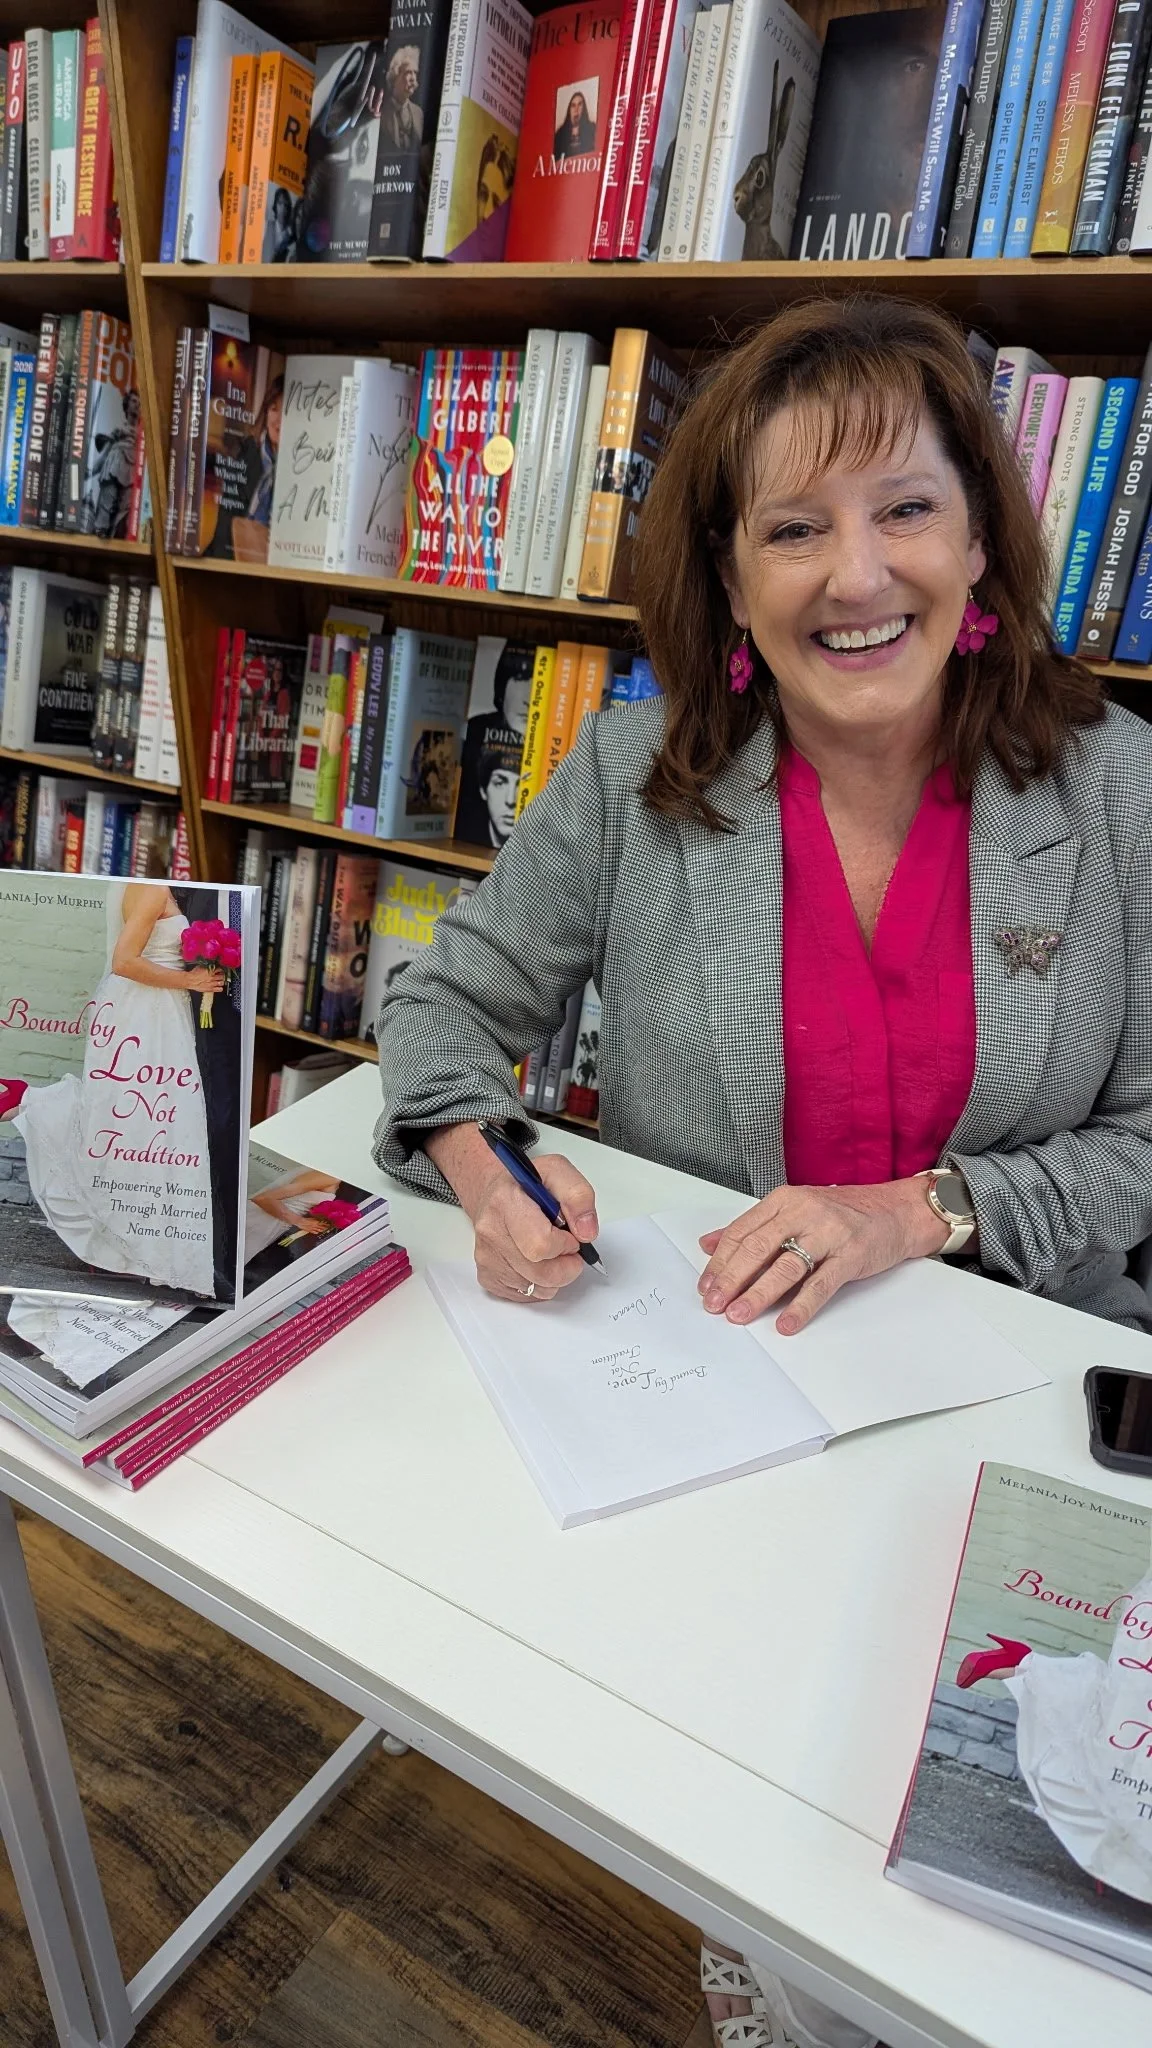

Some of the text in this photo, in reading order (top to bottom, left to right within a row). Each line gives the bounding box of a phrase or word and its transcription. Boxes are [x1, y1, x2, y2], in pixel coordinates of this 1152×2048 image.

[389, 12, 434, 31] TWAIN
[573, 9, 620, 45] Unc
[728, 0, 746, 68] AISING
[8, 47, 24, 120] UFO
[27, 40, 39, 123] BLACK MOSES
[62, 56, 73, 122] AMERICA
[681, 28, 706, 131] RAISING HARE
[697, 23, 722, 128] RAISING HARE
[976, 49, 998, 104] Dunne
[1008, 62, 1022, 89] SEA
[1040, 60, 1053, 86] SEA
[1104, 41, 1133, 89] JOHN
[54, 82, 63, 119] IRAN
[172, 73, 188, 132] Strangers
[76, 85, 101, 218] GREAT RESISTANCE
[605, 92, 631, 188] Vagabond
[631, 91, 658, 187] Vagabond
[918, 44, 957, 212] Maybe This Will Save Me
[1020, 100, 1048, 206] SOPHIE ELMHIRST
[1051, 72, 1082, 185] MELISSA FEBOS
[1082, 95, 1123, 203] FETTERMAN
[382, 164, 402, 178] RON
[532, 151, 603, 178] A Memoi
[964, 141, 986, 200] The Friday
[987, 101, 1015, 207] SOPHIE ELMHIRST
[438, 178, 449, 211] EDEN
[667, 145, 688, 233] CHLOE DALTON
[683, 143, 702, 231] CHLOE DALTON
[1122, 161, 1138, 207] FINKEL
[1131, 155, 1147, 212] MICHAEL
[701, 194, 716, 254] DALTON
[13, 360, 34, 374] 2026
[37, 322, 54, 374] EDEN
[78, 310, 94, 387] ORDINARY
[170, 339, 188, 437] Ina Garten
[189, 372, 206, 438] Garten
[212, 398, 257, 426] Garten
[226, 380, 247, 403] Ina
[284, 378, 341, 423] Notes
[426, 377, 521, 404] ELIZABETH
[28, 382, 48, 464] UNDONE
[72, 387, 88, 459] EQUALITY
[432, 408, 513, 435] GILBERT
[1024, 381, 1049, 454] EVERYONE'S
[1059, 396, 1086, 483] STRONG ROOTS
[1087, 385, 1126, 492] SECOND LIFE
[7, 387, 28, 510] WORLD ALMANAC
[227, 454, 248, 470] Ready
[1123, 423, 1152, 497] FOR GOD
[428, 472, 500, 498] ALL THE
[419, 499, 502, 529] WAY TO
[513, 465, 534, 558] Virginia Roberts
[542, 470, 565, 562] Virginia Roberts
[356, 545, 399, 569] French
[411, 528, 505, 560] THE RIVER
[1090, 507, 1132, 622] JOSIAH HESSE
[1055, 528, 1092, 644] AMANDA HESS
[64, 606, 100, 632] COLD
[67, 631, 94, 655] WAR
[63, 669, 88, 690] FIVE
[367, 644, 385, 718] GEDDY LEE
[553, 657, 572, 730] BETH MACY
[585, 660, 597, 694] BETH
[260, 707, 290, 729] That
[483, 727, 519, 744] JOHN
[523, 679, 546, 769] Only Drowning
[0, 891, 105, 910] LANIA JOY MURPHY
[332, 887, 345, 919] WAY
[386, 873, 461, 924] Judy
[0, 997, 118, 1049] Bound by
[89, 1036, 201, 1095] Love,
[548, 1060, 558, 1079] LIFE
[112, 1090, 178, 1125] Not
[88, 1129, 202, 1169] Tradition
[92, 1175, 208, 1199] Empowering Women
[110, 1198, 209, 1221] Through Married
[126, 1222, 208, 1243] Name Choices
[66, 1316, 130, 1354] Name Choices
[74, 1300, 115, 1324] Through
[109, 1318, 152, 1343] Married
[131, 1308, 165, 1331] Women
[590, 1344, 641, 1367] Tradition
[607, 1368, 657, 1391] Love,
[610, 1360, 641, 1378] Not
[654, 1365, 709, 1394] Bound by
[161, 1395, 184, 1414] Bound
[209, 1371, 221, 1382] Not
[998, 1476, 1150, 1527] MELANIA JOY MURPHY
[1002, 1567, 1134, 1623] Bound
